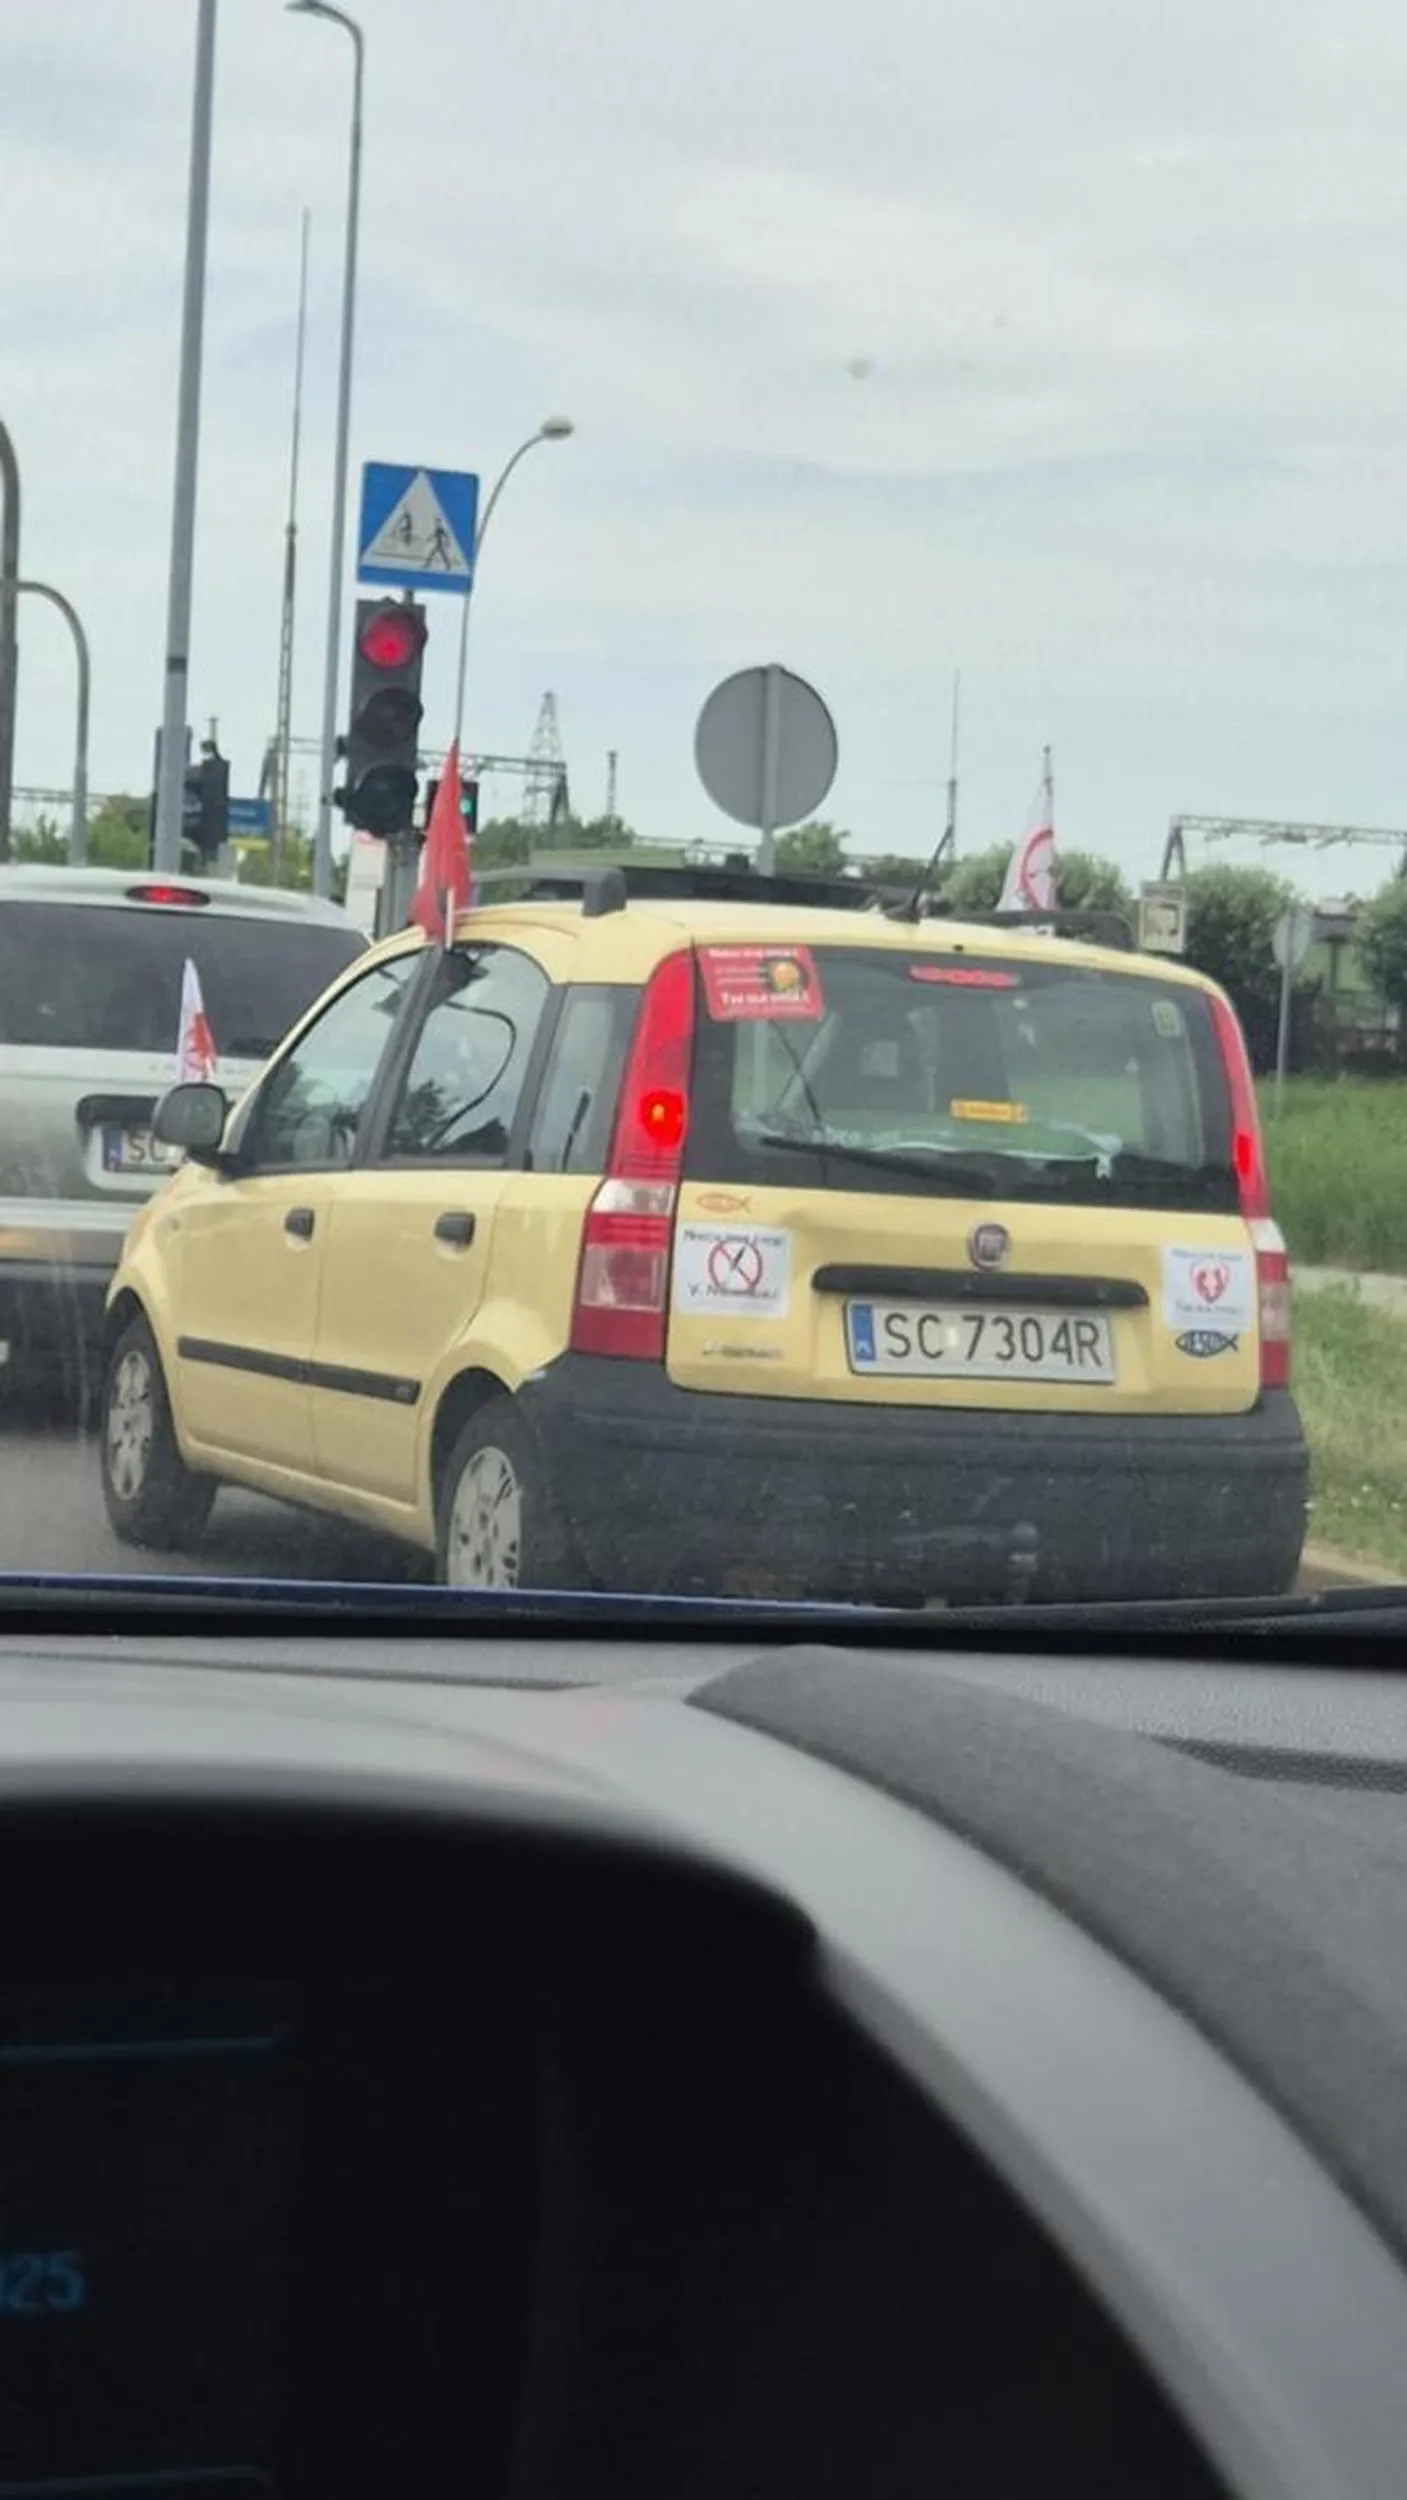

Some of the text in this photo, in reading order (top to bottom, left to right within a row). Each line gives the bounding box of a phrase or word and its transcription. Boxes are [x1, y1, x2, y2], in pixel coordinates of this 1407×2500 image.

[884, 1312, 1103, 1368] SC 7304R
[0, 2249, 85, 2314] 25
